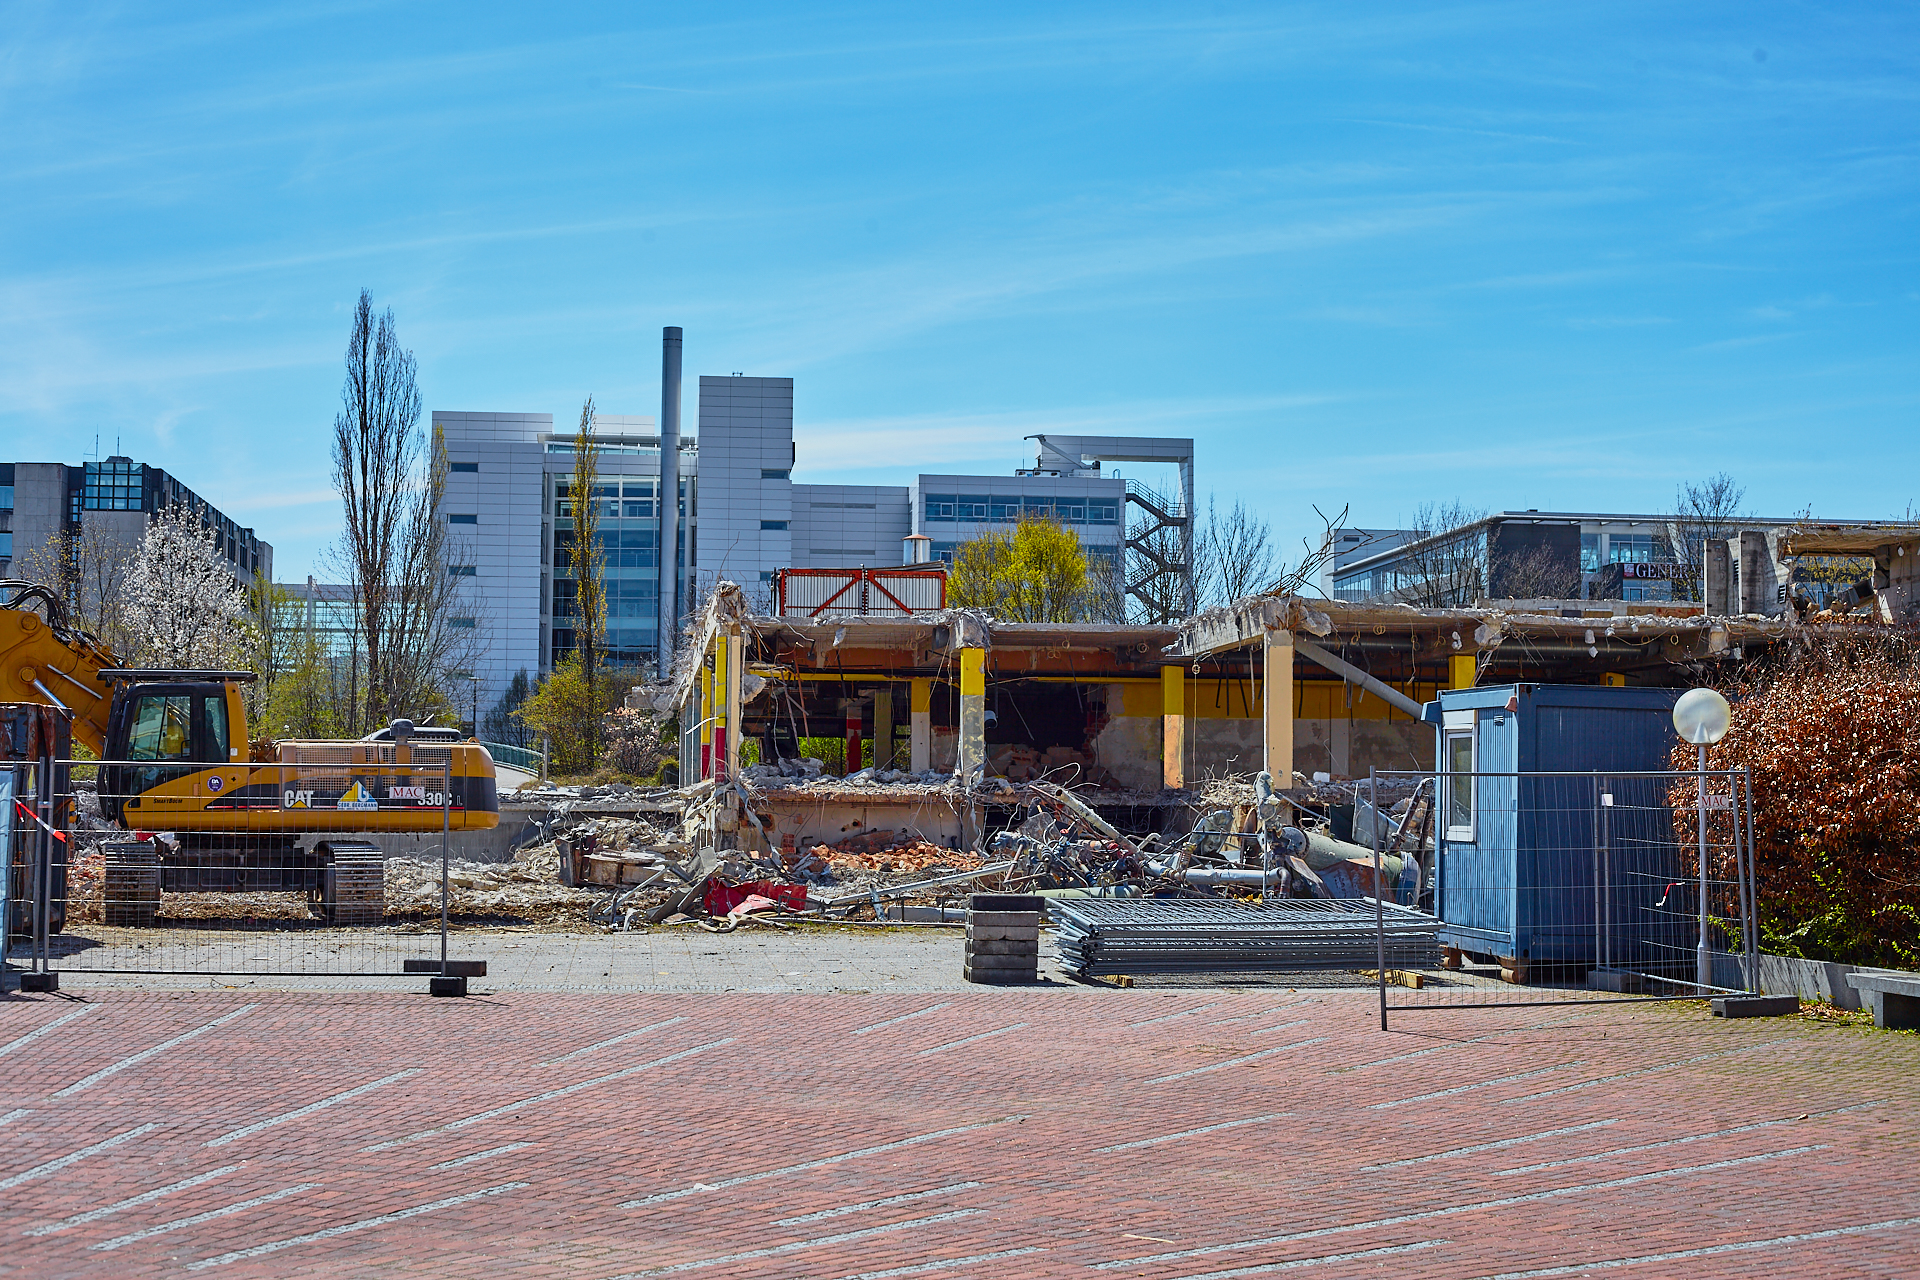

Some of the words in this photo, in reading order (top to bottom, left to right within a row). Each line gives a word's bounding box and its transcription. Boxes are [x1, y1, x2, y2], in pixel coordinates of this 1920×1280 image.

[393, 787, 424, 798] MAC
[284, 789, 314, 809] CAT
[1701, 795, 1727, 807] MAC
